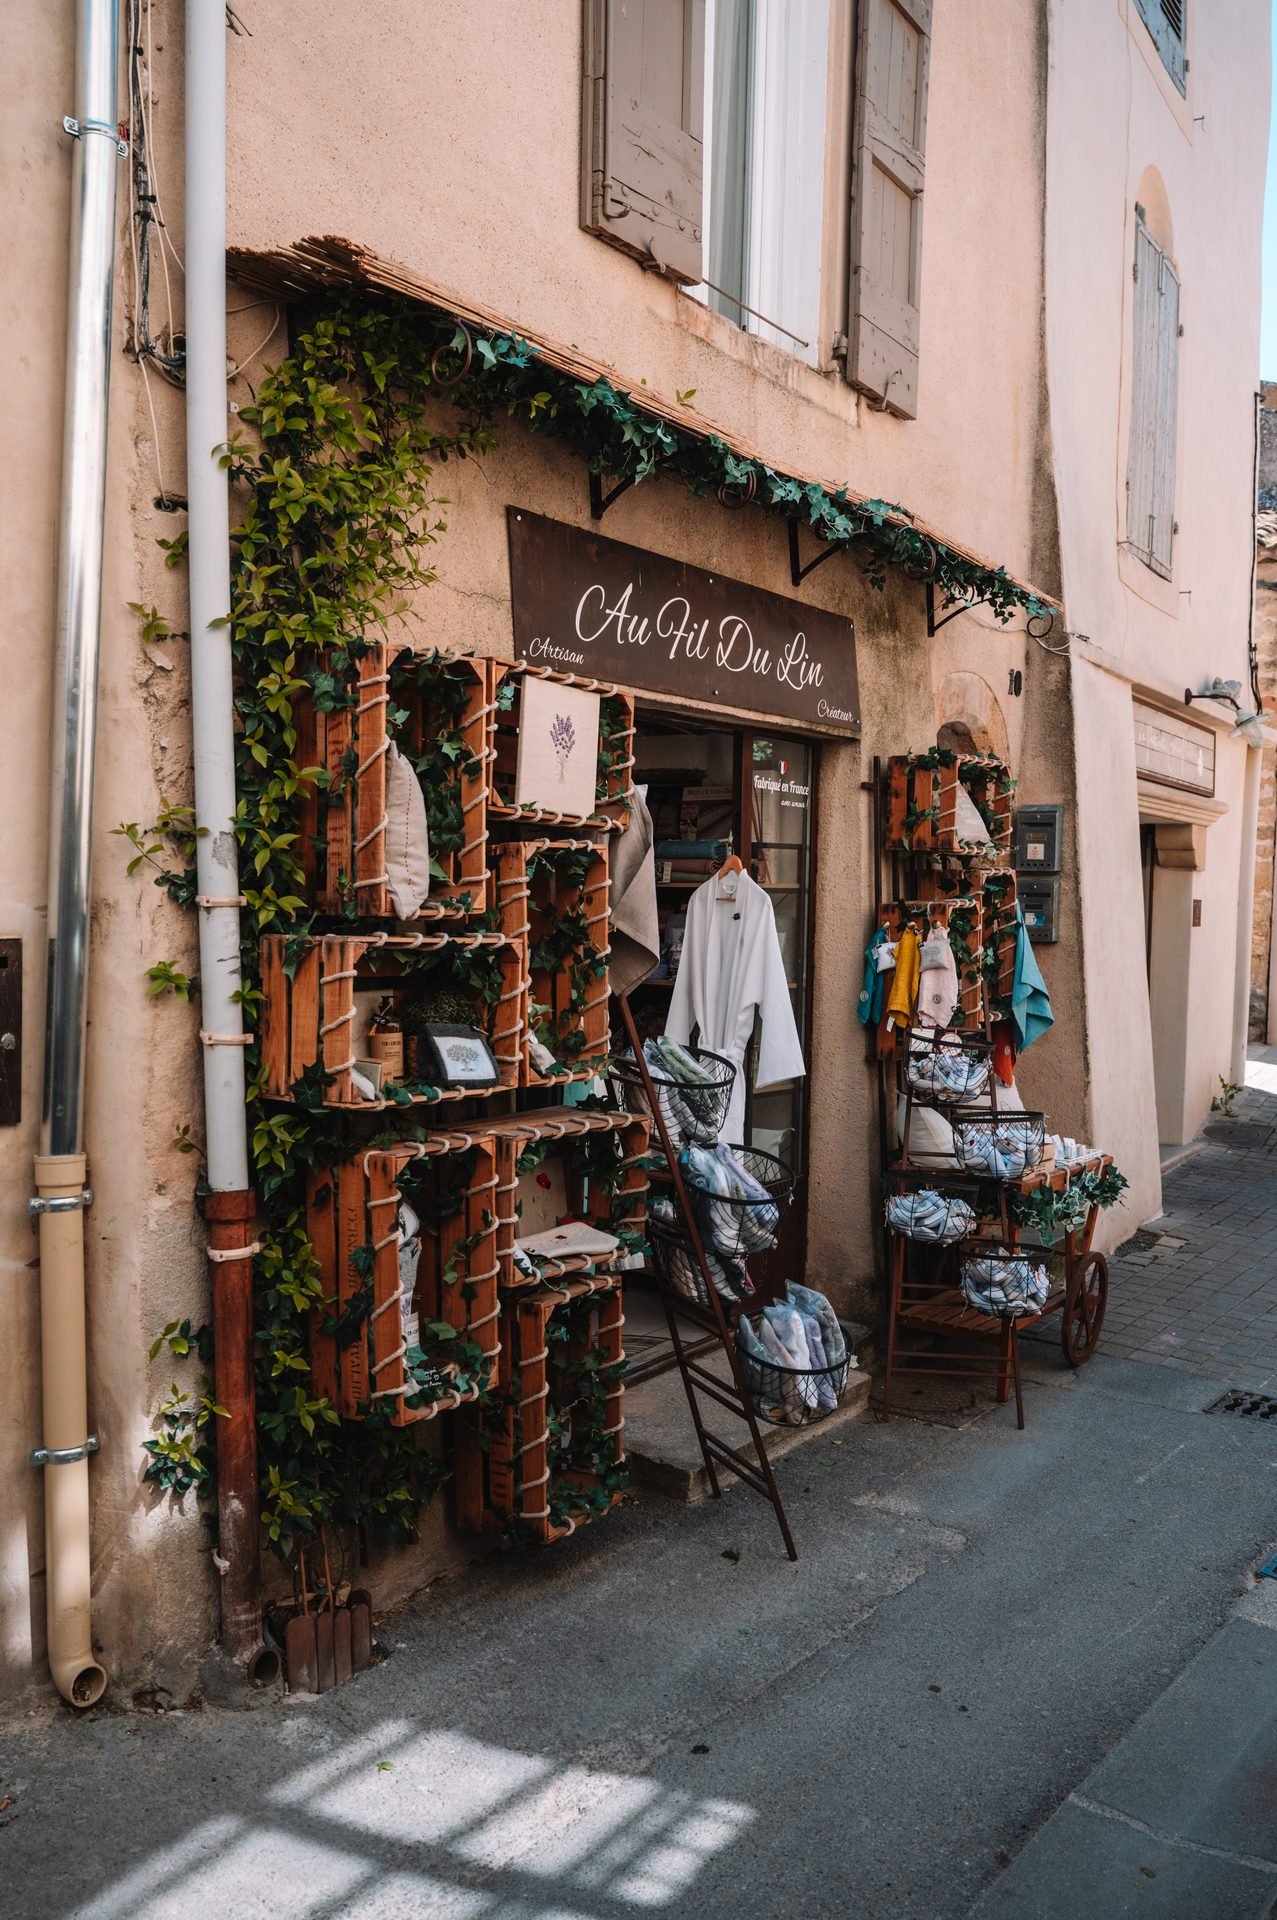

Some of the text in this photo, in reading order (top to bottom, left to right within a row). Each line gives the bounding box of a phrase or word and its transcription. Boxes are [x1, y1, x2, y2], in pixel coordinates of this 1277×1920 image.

[575, 582, 825, 691] Au Fil Du Lin
[529, 637, 585, 666] Artisan
[816, 699, 854, 722] Créateur
[753, 775, 809, 795] Fabriqué en France
